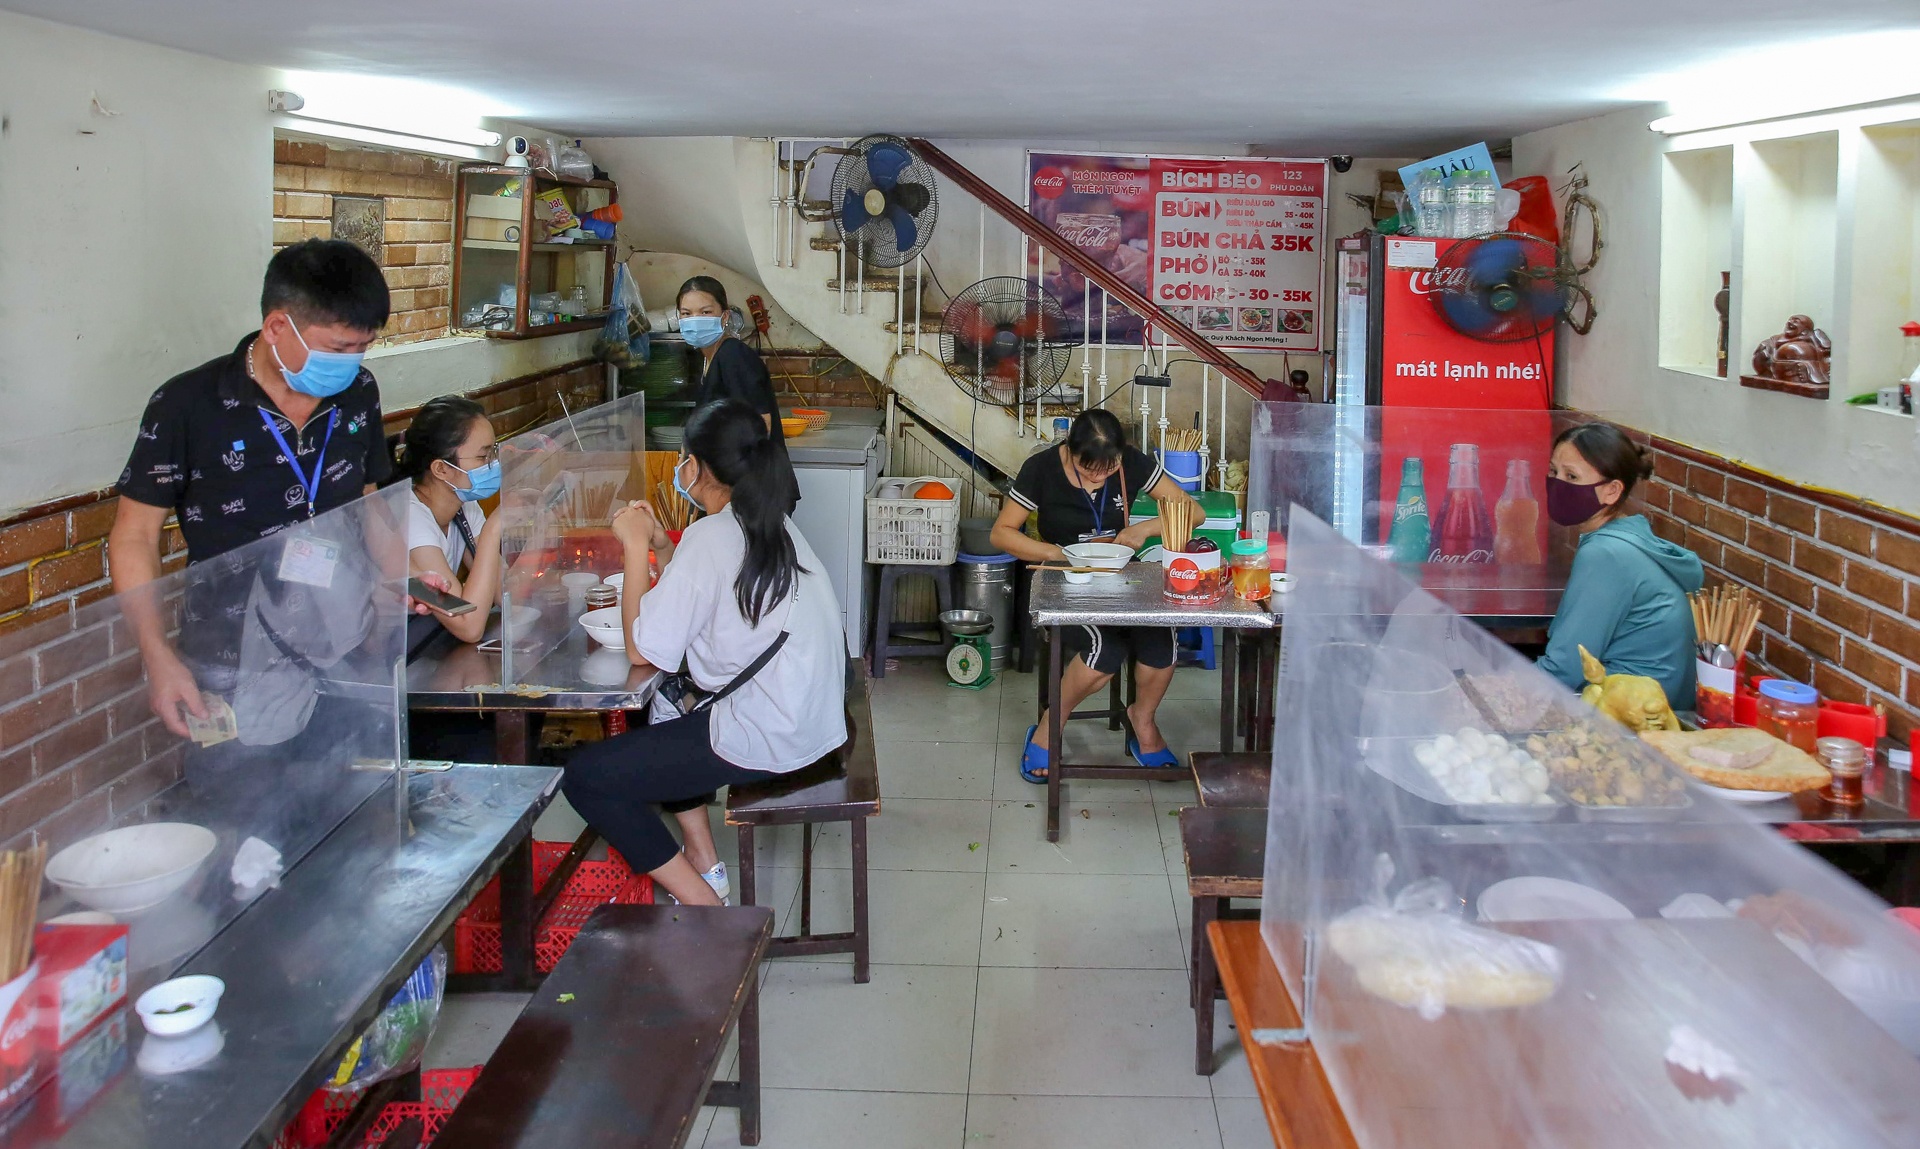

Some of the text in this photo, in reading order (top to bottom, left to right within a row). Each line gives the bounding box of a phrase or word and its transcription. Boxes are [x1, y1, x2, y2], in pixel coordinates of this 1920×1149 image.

[1100, 171, 1135, 182] NGON
[1162, 168, 1262, 189] BÍCH BÉO
[1282, 170, 1303, 180] 123
[1072, 183, 1142, 197] THÊM TUYỆT
[1161, 197, 1211, 217] BÚN
[1161, 228, 1314, 252] BÚN CHẢ 35K
[1160, 253, 1209, 274] PHỞ
[1218, 254, 1230, 264] BÒ
[1250, 257, 1266, 265] 35K
[1218, 267, 1230, 276] GÀ
[1233, 269, 1243, 277] 35
[1249, 269, 1266, 277] 40K
[1160, 281, 1211, 301] CƠM
[1249, 288, 1269, 300] 30
[1282, 290, 1313, 302] 35K
[1396, 360, 1541, 381] mát lạnh nhé!
[1396, 502, 1428, 521] Sprite
